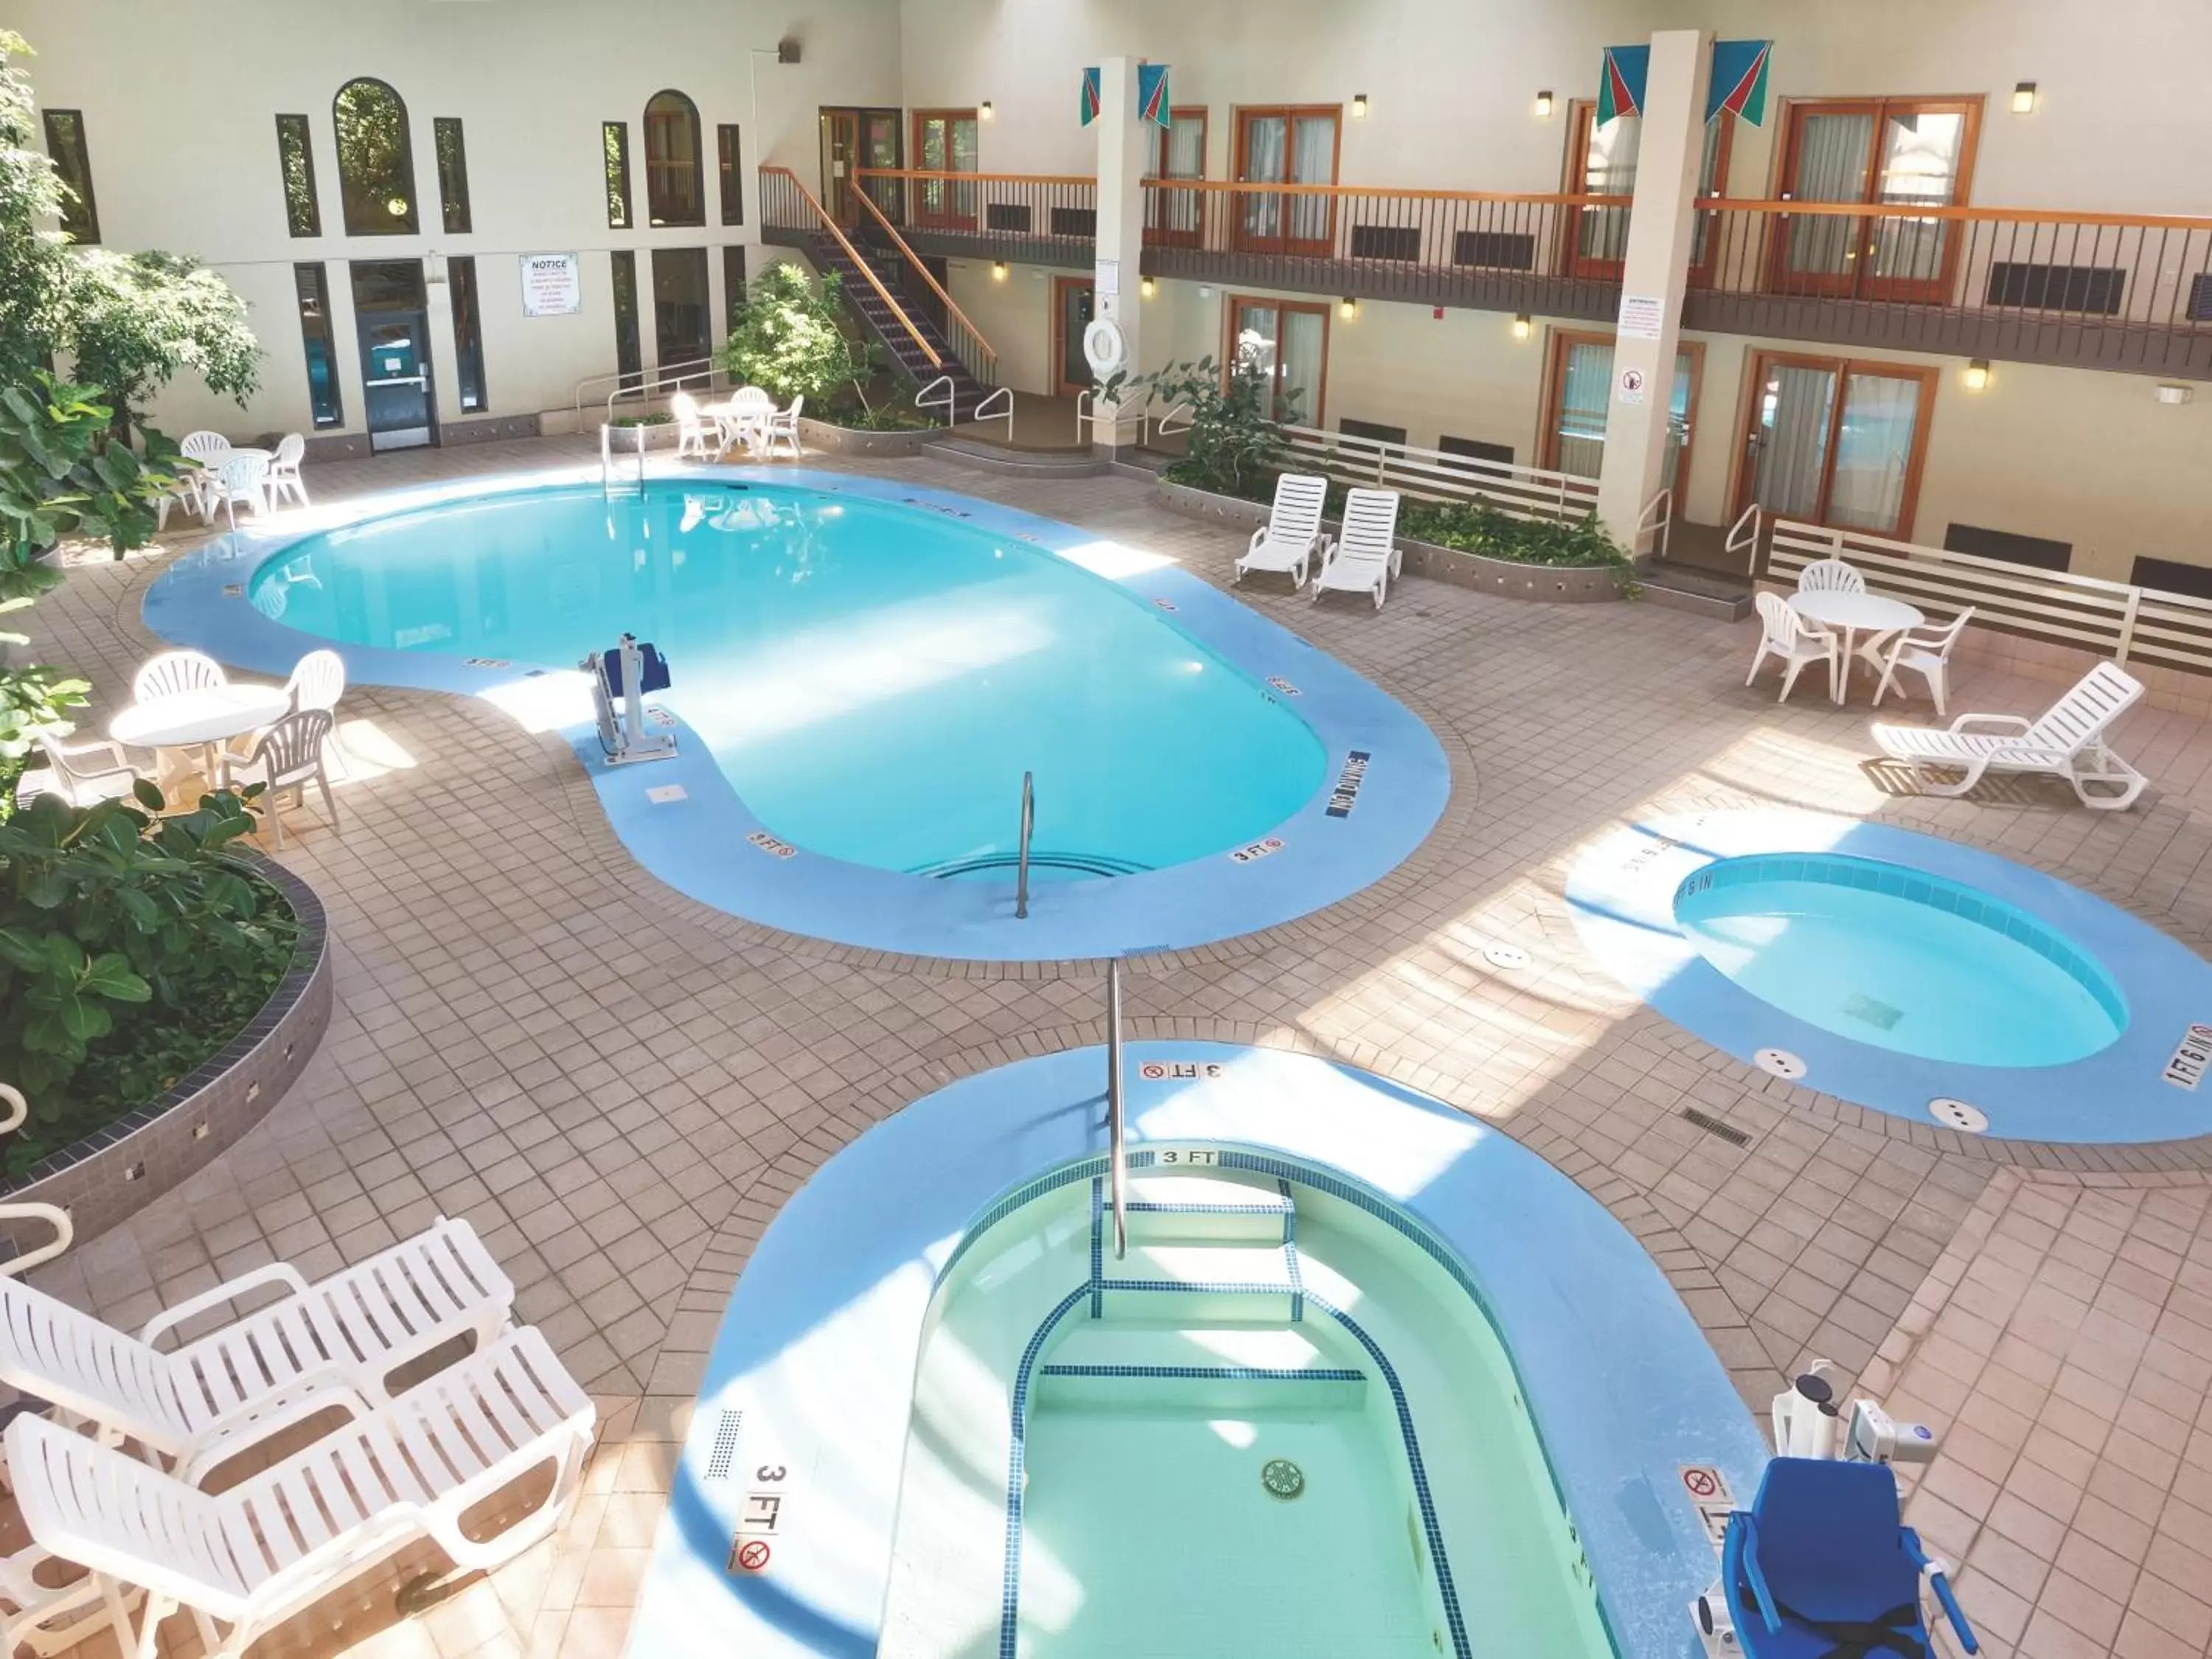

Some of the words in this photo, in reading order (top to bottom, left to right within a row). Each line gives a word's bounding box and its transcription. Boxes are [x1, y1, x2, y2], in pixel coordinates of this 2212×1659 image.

[532, 259, 567, 269] NOTICE
[1335, 758, 1368, 790] DIVING
[1329, 793, 1354, 810] NO
[759, 839, 782, 850] FT
[1234, 852, 1249, 860] 3
[1247, 844, 1268, 856] FT
[2180, 1049, 2206, 1061] 6
[1172, 1064, 1197, 1078] FT
[1206, 1064, 1221, 1078] 3
[2171, 1058, 2200, 1077] FT
[2166, 1073, 2193, 1085] 1
[1163, 1151, 1178, 1163] 3
[1189, 1150, 1216, 1164] FT
[757, 1465, 787, 1482] 3
[744, 1496, 781, 1530] FT
